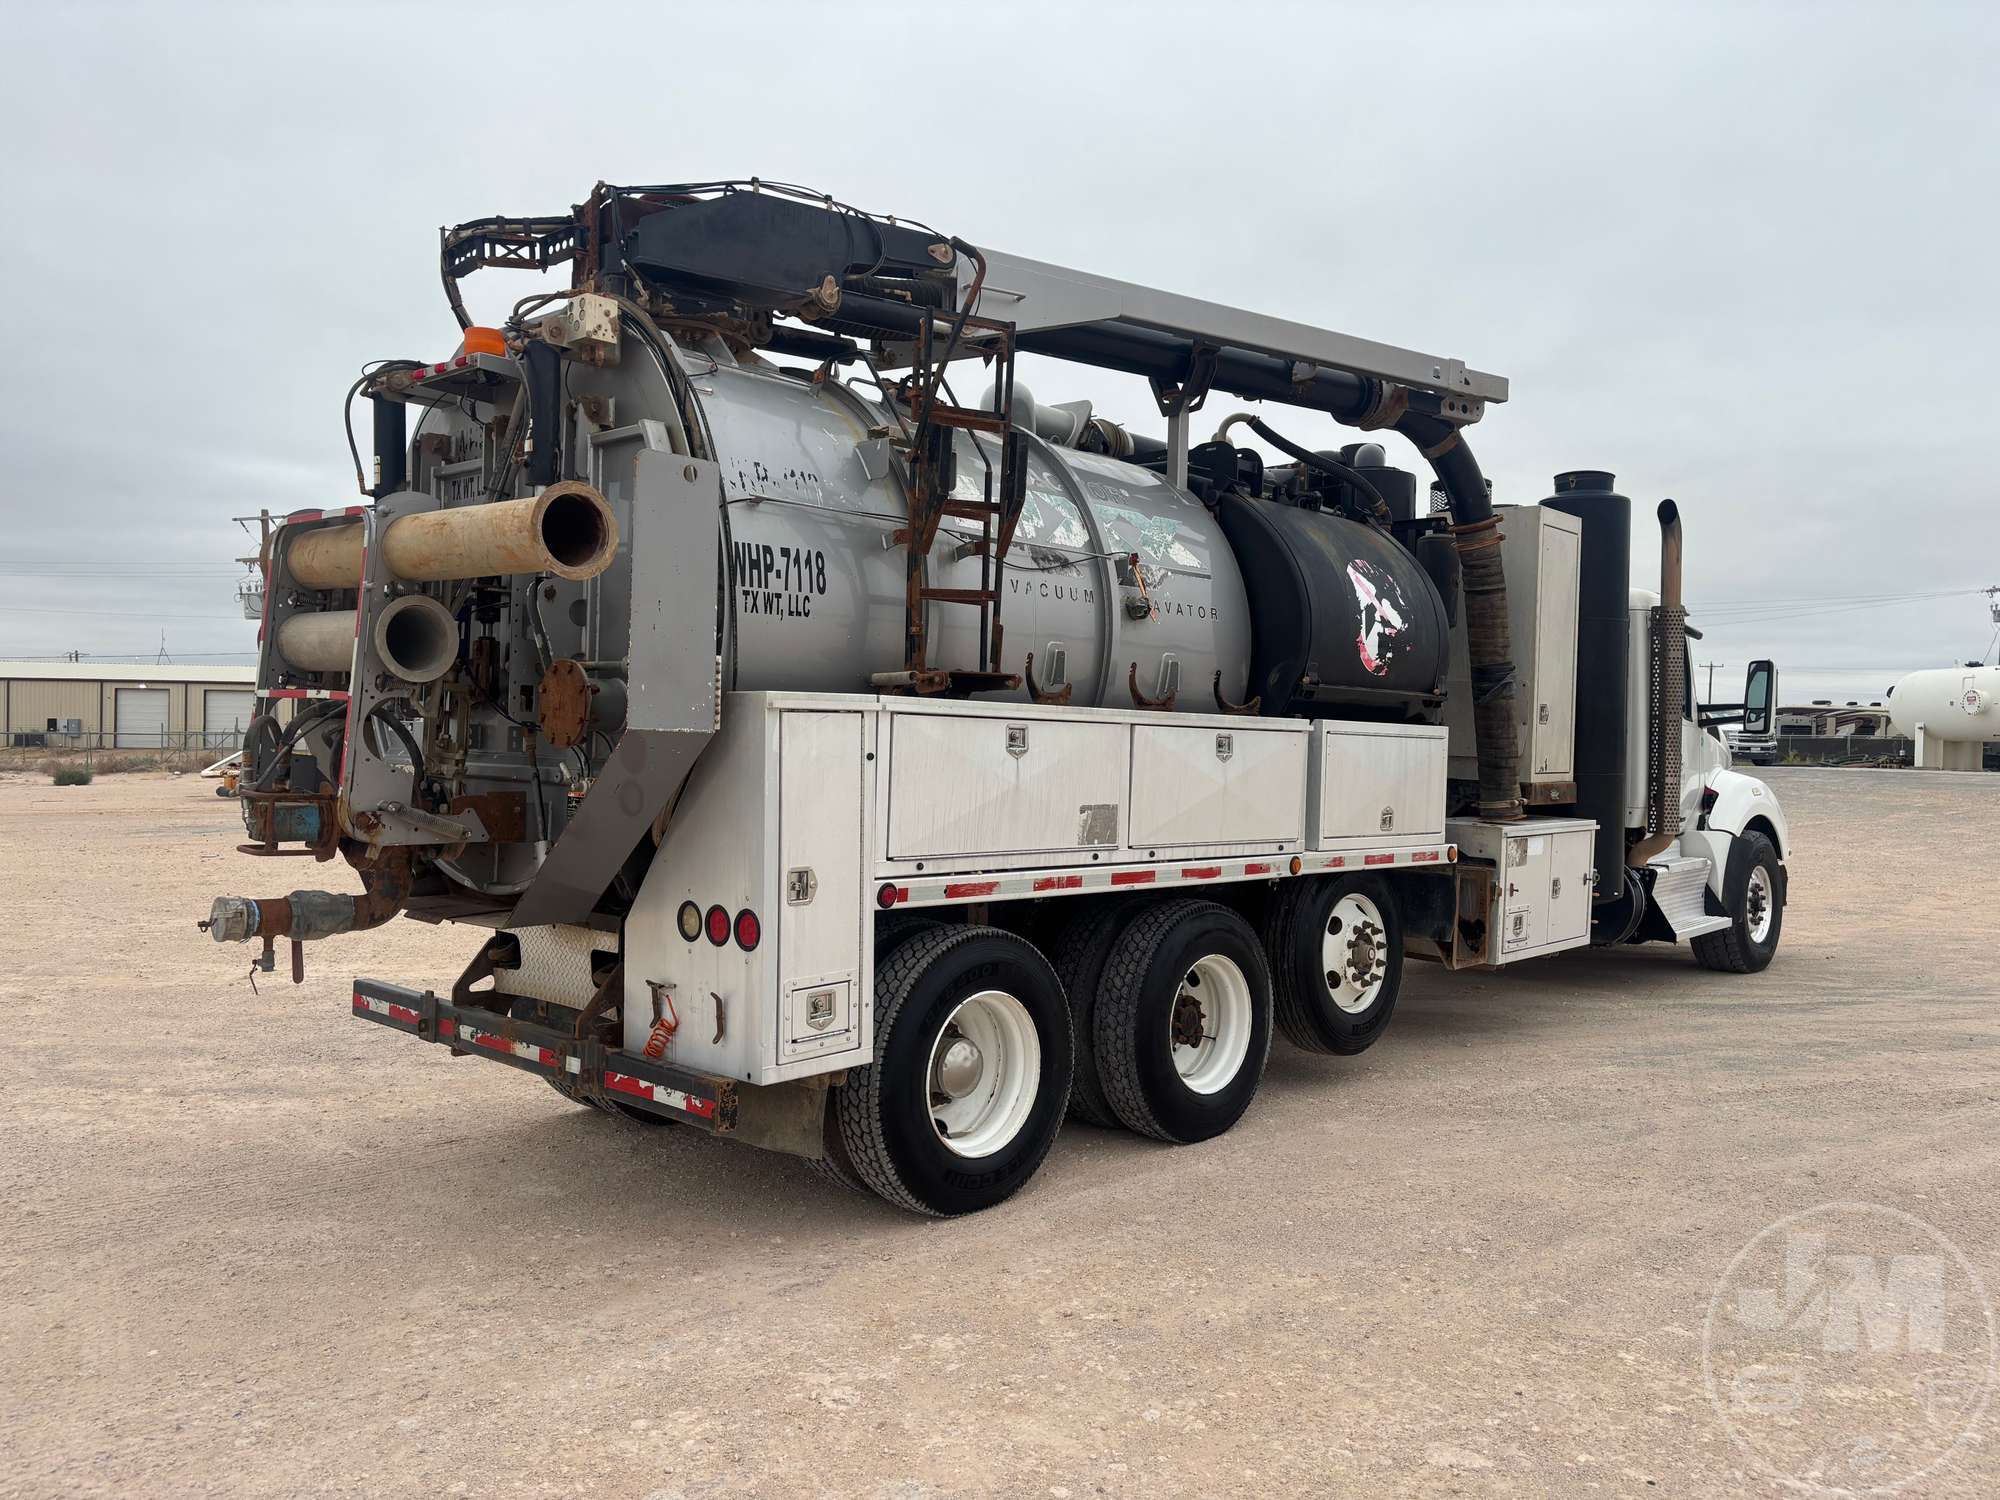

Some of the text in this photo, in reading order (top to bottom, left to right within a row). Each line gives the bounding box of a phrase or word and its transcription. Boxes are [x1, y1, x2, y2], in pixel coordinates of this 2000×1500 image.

[734, 541, 827, 595] WHP-7118
[742, 589, 811, 621] TX WT, LLC
[1010, 578, 1094, 604] VACUUM
[1152, 599, 1219, 621] AVATOR
